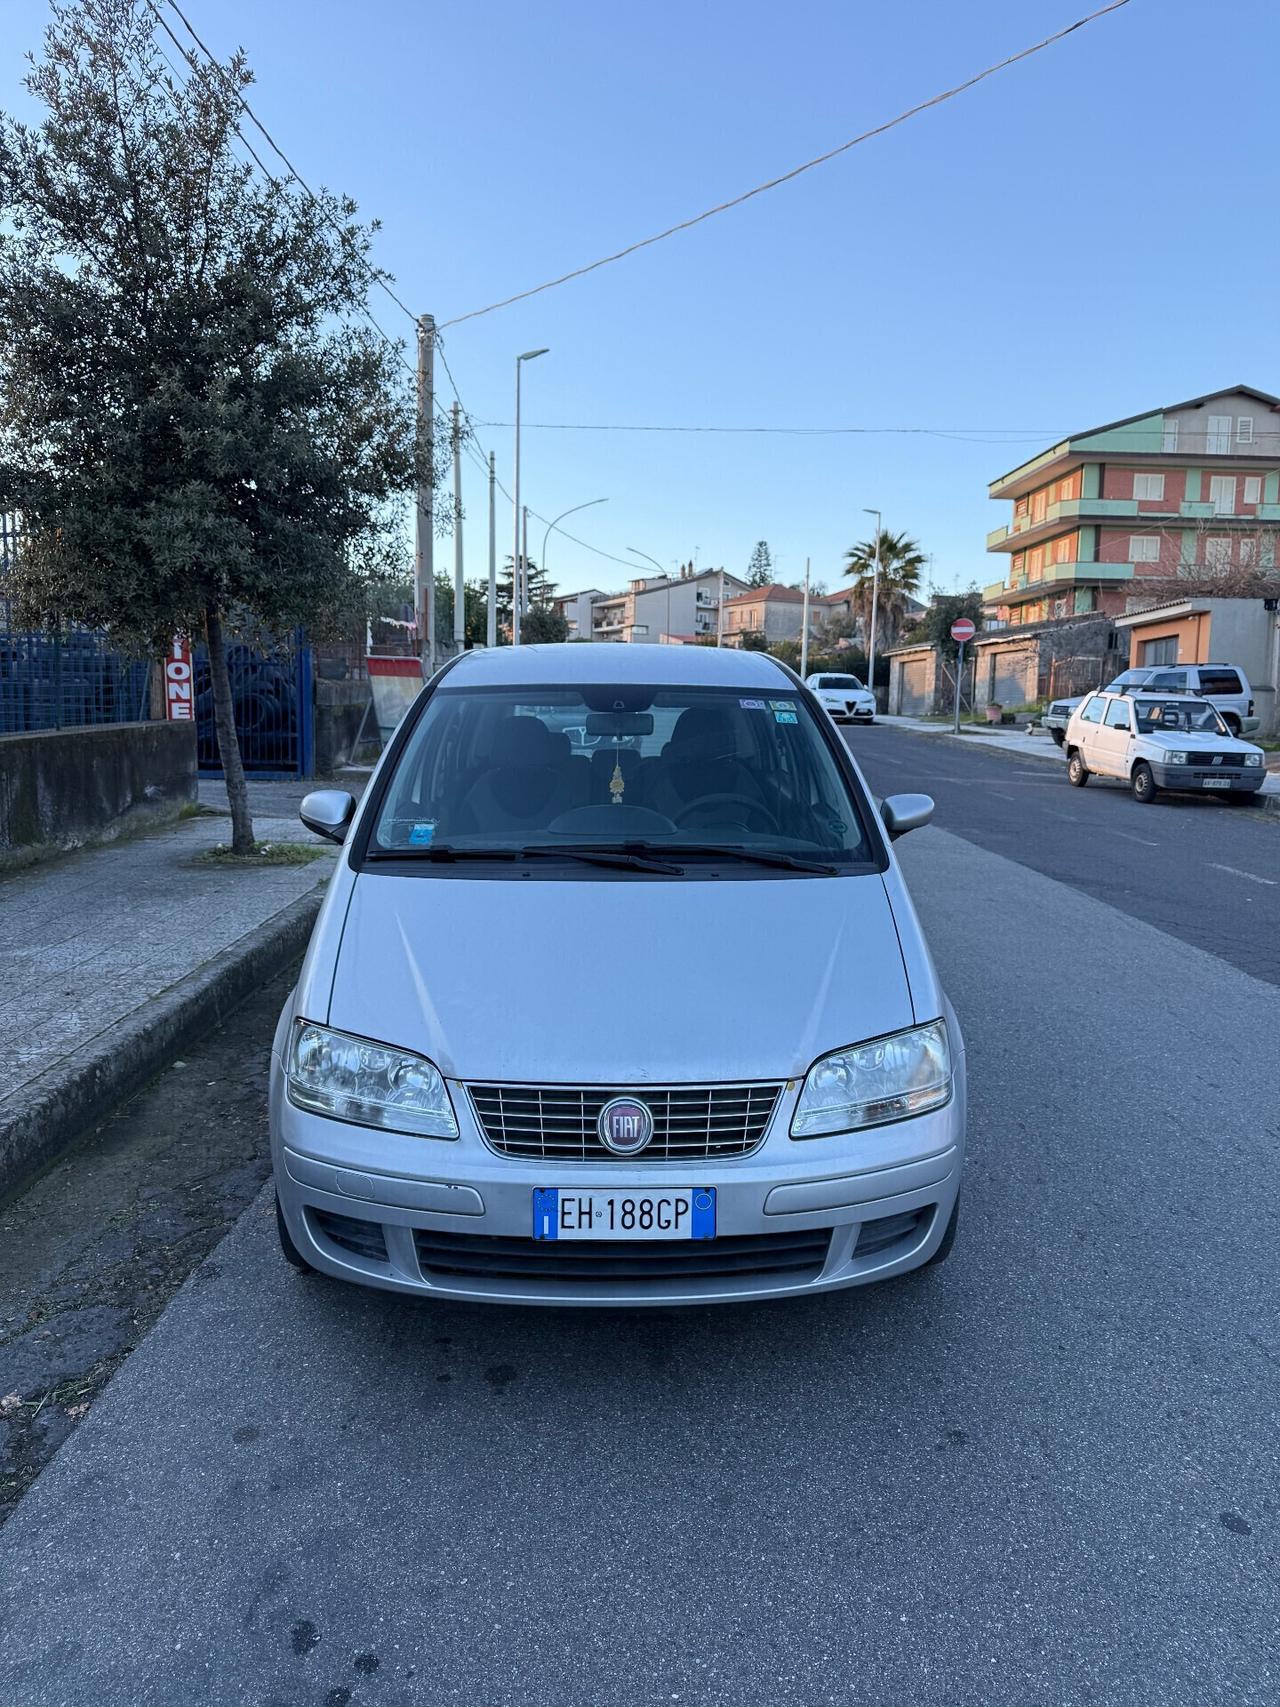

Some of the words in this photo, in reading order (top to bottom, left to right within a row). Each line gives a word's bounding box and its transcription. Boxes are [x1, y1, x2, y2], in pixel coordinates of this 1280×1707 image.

[612, 1116, 640, 1138] FIAT
[560, 1198, 592, 1229] EH
[607, 1198, 689, 1230] 188GP
